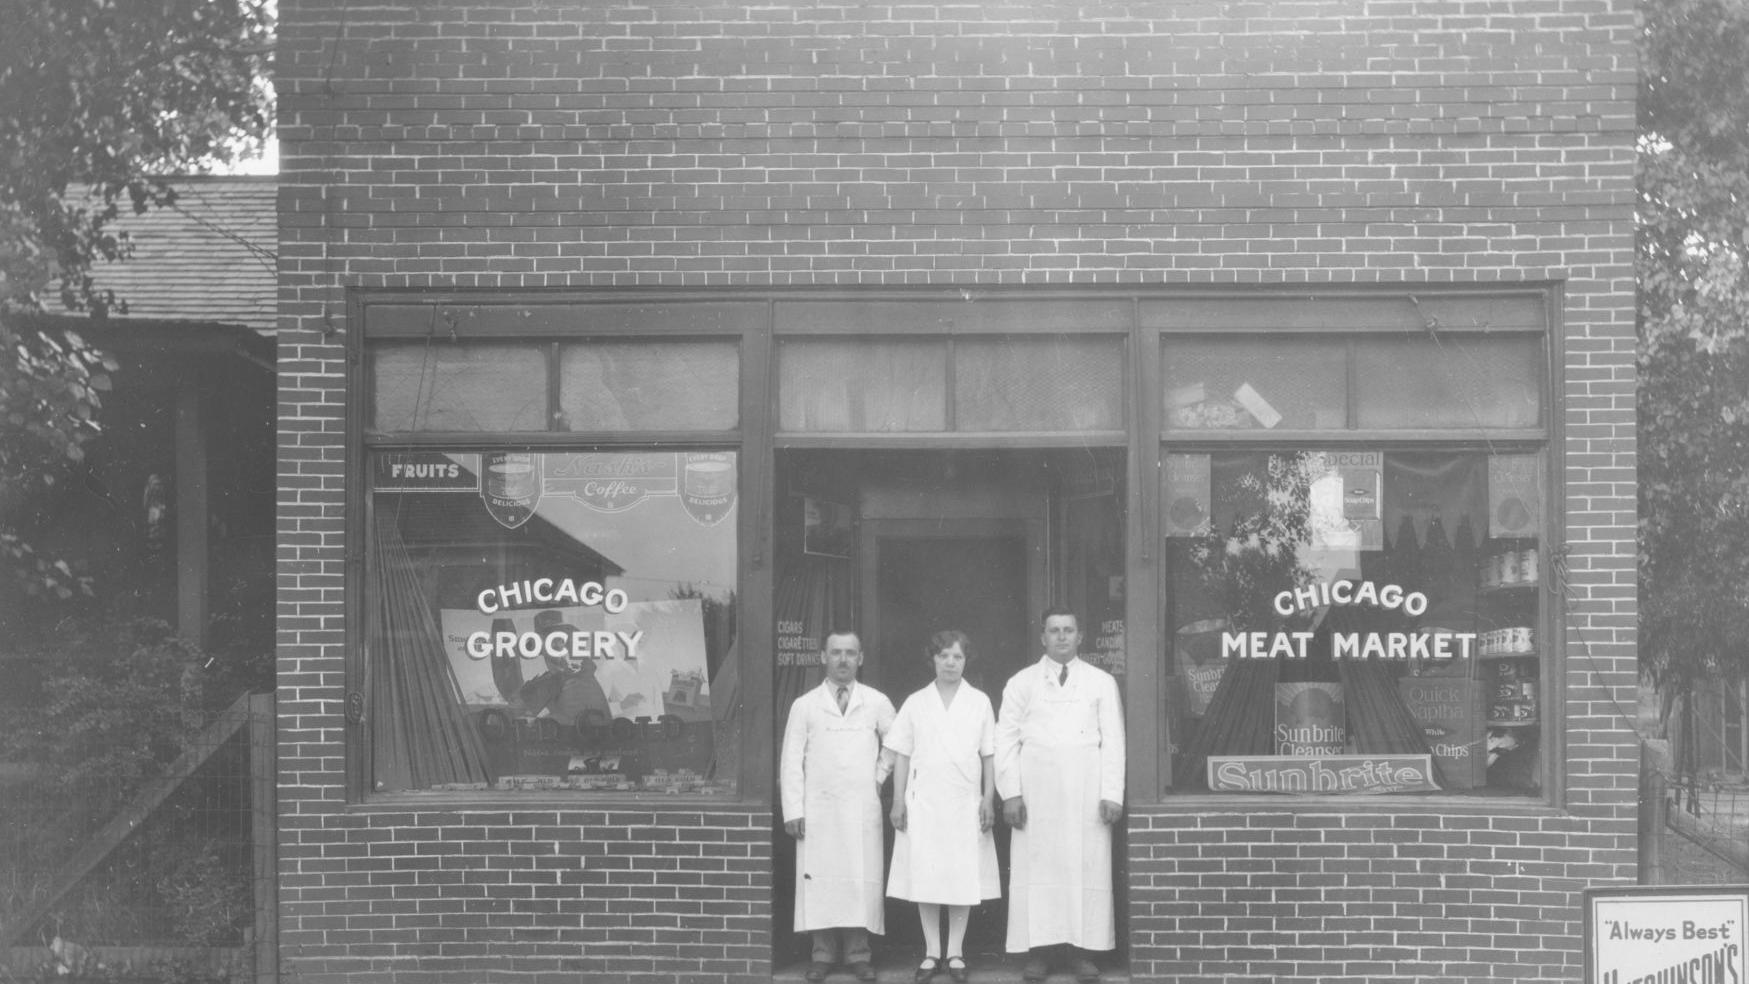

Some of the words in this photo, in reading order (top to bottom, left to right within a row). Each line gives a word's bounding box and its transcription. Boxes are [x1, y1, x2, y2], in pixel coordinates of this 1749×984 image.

[392, 464, 459, 479] FRUITS
[583, 480, 637, 498] Coffee
[492, 498, 531, 507] DELICIOUS
[688, 497, 728, 506] DELICIOUS
[477, 577, 629, 614] CHICAGO
[1273, 580, 1428, 616] CHICAGO
[778, 620, 803, 634] CIGARS
[466, 630, 644, 660] GROCERY
[1220, 631, 1314, 658] MEAT
[1333, 632, 1477, 659] MARKET
[778, 652, 795, 666] SOFT
[1187, 667, 1226, 682] Sunbr
[1192, 680, 1220, 693] Clea
[1408, 686, 1461, 704] Quick
[1277, 723, 1344, 743] Sunbrite
[1435, 743, 1470, 760] Chips
[1217, 760, 1425, 791] Sunbrite
[1603, 943, 1738, 984] NSON'S
